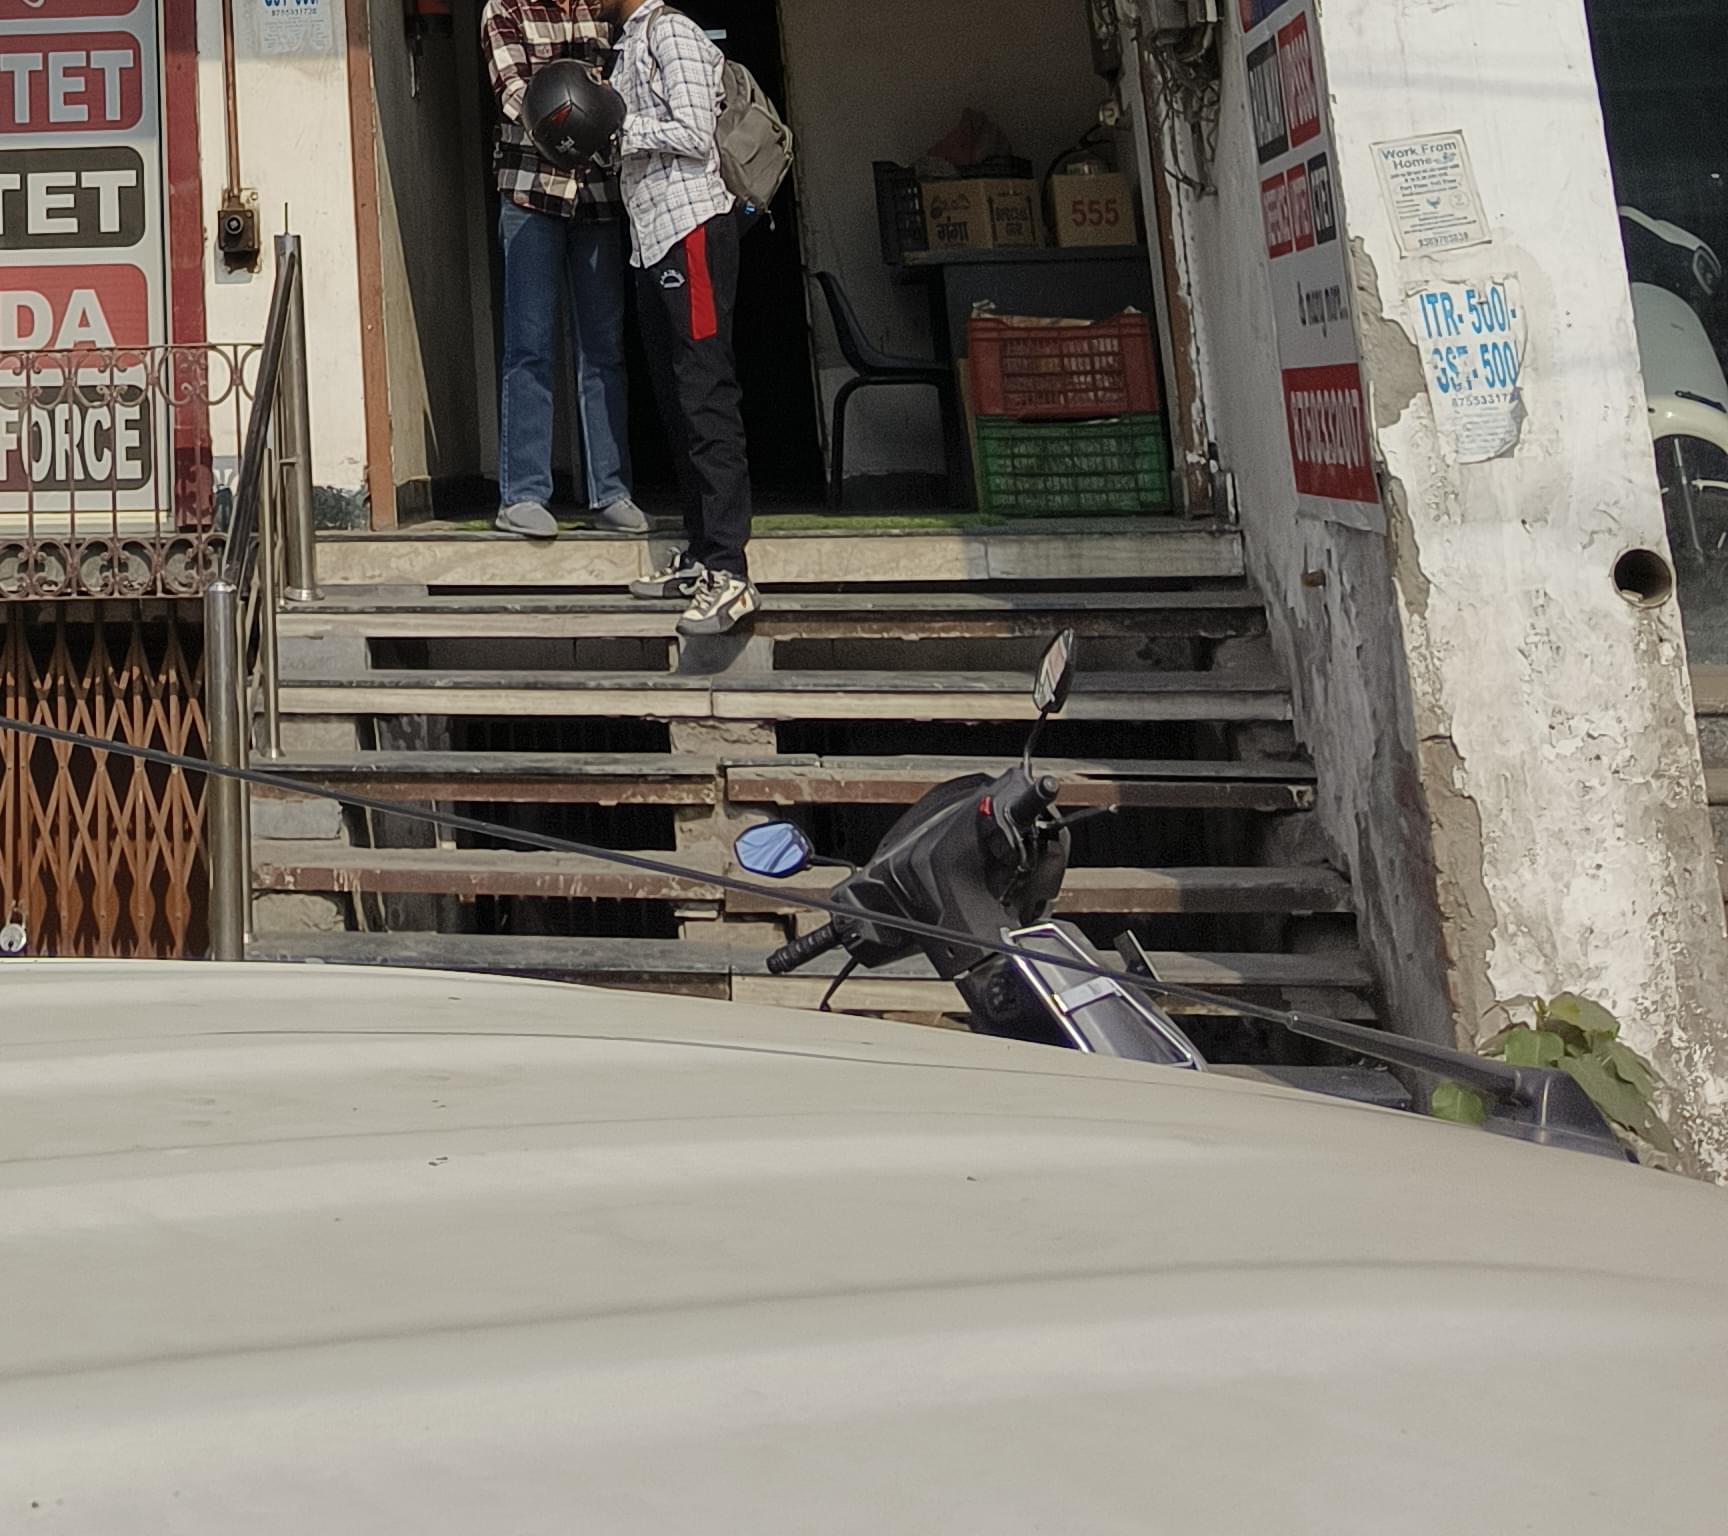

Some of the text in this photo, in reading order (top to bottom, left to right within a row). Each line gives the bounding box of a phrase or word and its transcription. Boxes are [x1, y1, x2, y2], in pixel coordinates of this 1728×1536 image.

[1382, 142, 1457, 160] Work From
[1071, 199, 1120, 227] 555
